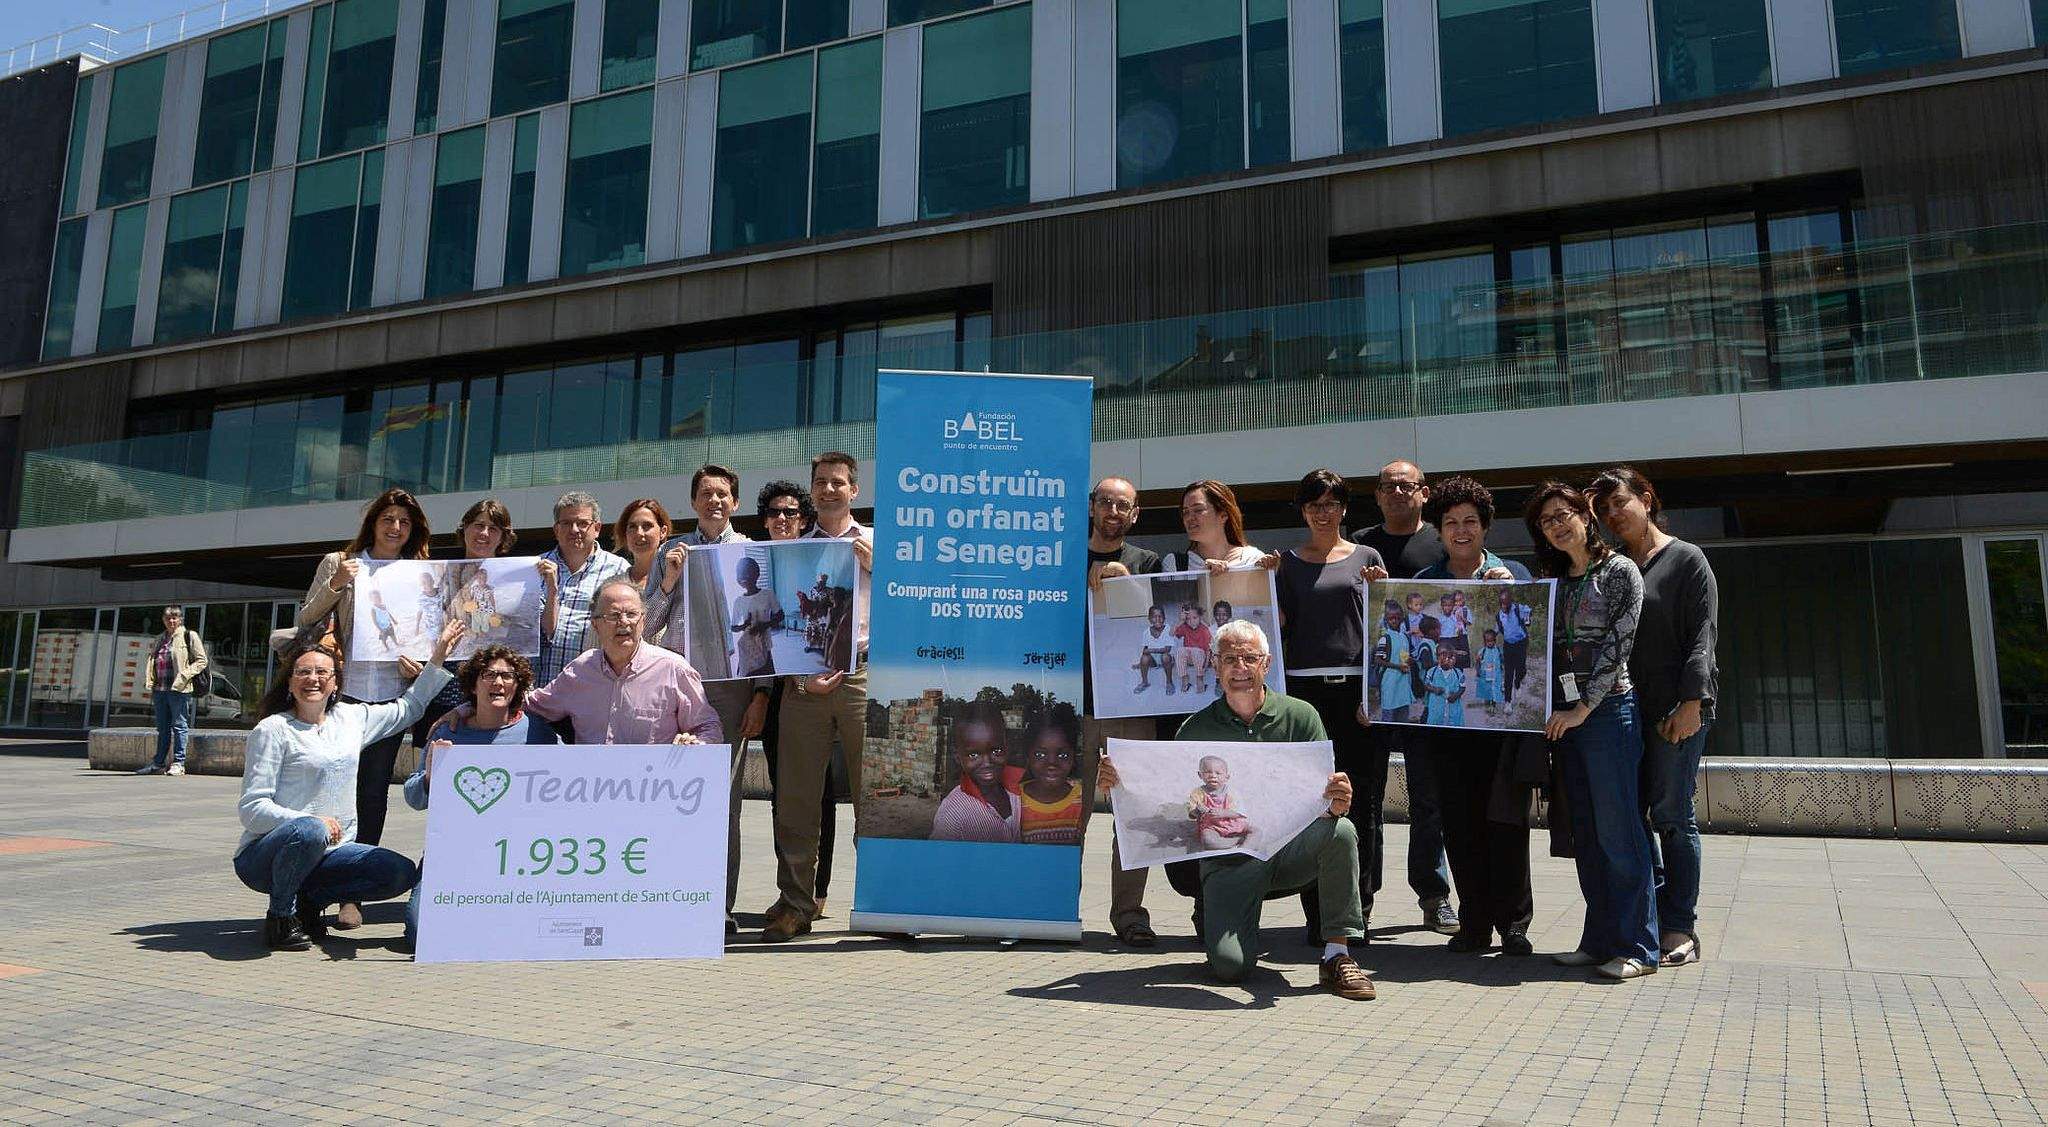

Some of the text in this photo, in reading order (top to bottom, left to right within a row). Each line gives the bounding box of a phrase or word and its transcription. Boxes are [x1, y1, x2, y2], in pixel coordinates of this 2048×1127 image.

[943, 412, 1024, 441] BABEL
[978, 412, 1016, 421] Fundación
[943, 442, 1018, 451] punto de encuentro
[898, 467, 1065, 498] Construïm
[895, 503, 1065, 533] un orfanat
[895, 534, 1063, 572] al Senegal
[887, 582, 1068, 604] Comprant una rosa poses
[931, 602, 1024, 620] DOS TOTXOS
[515, 765, 706, 816] Teaming
[495, 837, 649, 876] 1.933 €
[433, 890, 455, 905] del
[457, 890, 513, 907] personal
[516, 890, 533, 904] de
[621, 889, 638, 902] de
[641, 888, 670, 902] Sant
[672, 889, 712, 906] Cugat
